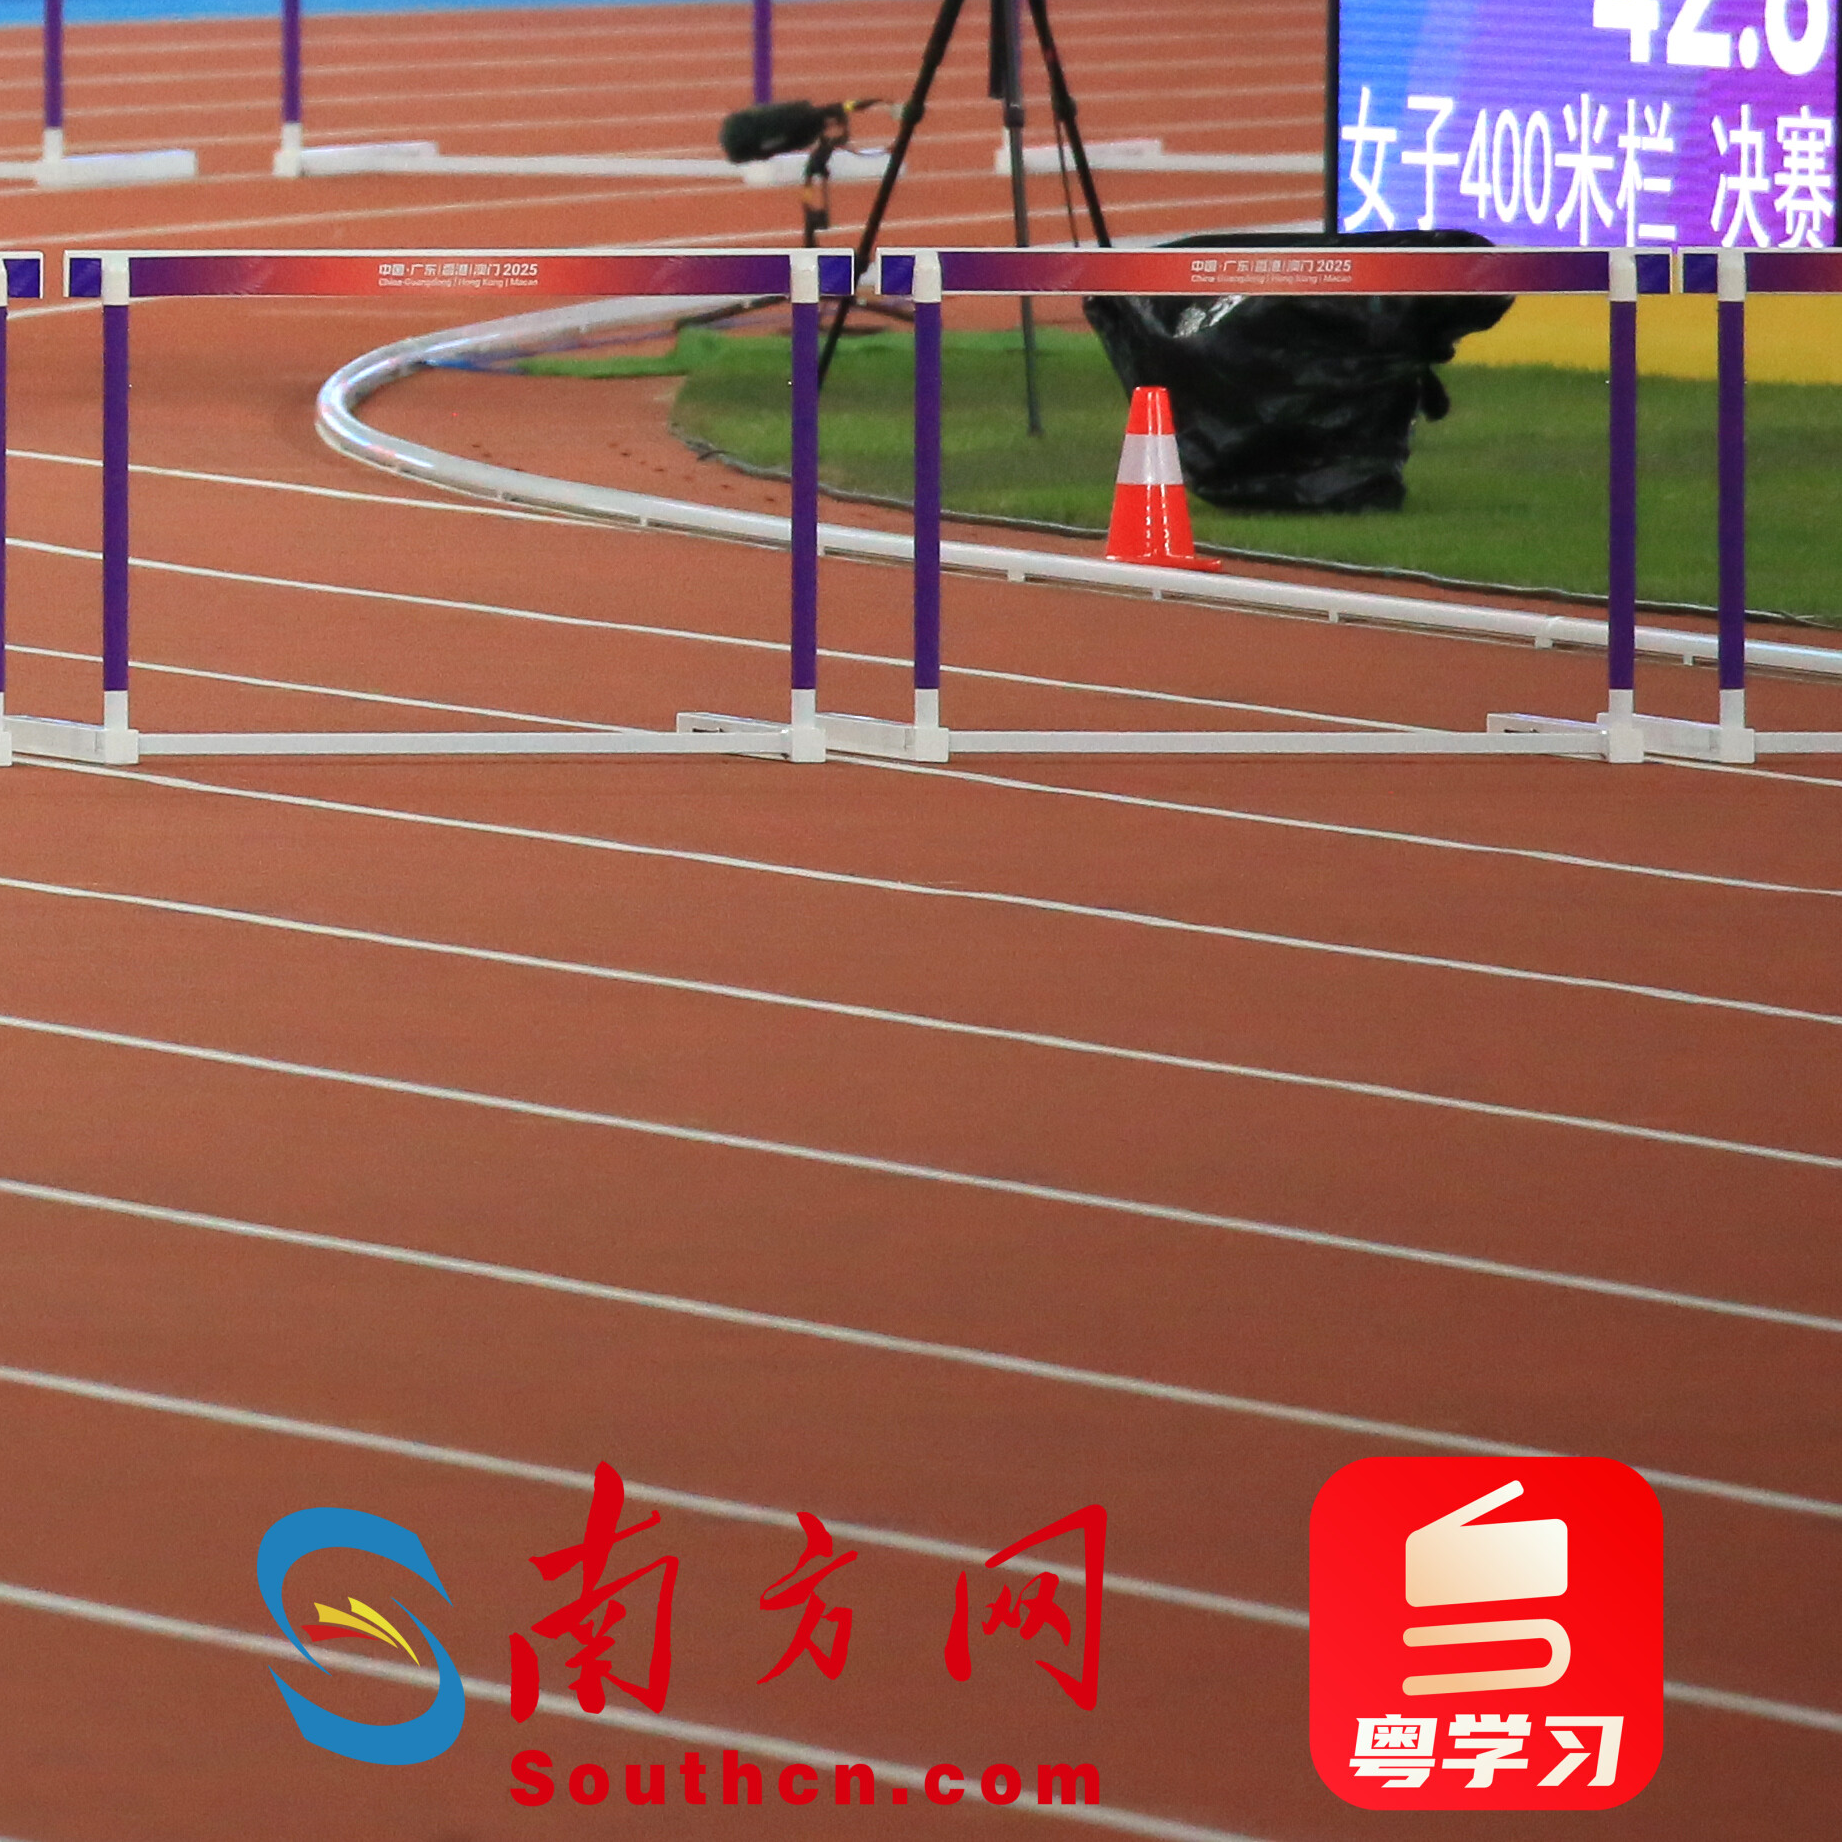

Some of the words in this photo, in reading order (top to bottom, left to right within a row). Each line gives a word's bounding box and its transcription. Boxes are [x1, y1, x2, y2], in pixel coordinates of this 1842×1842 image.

[1341, 85, 1678, 249] 女子400米栏
[1709, 103, 1835, 249] 决赛
[503, 263, 538, 276] 2025
[1317, 260, 1352, 272] 2025
